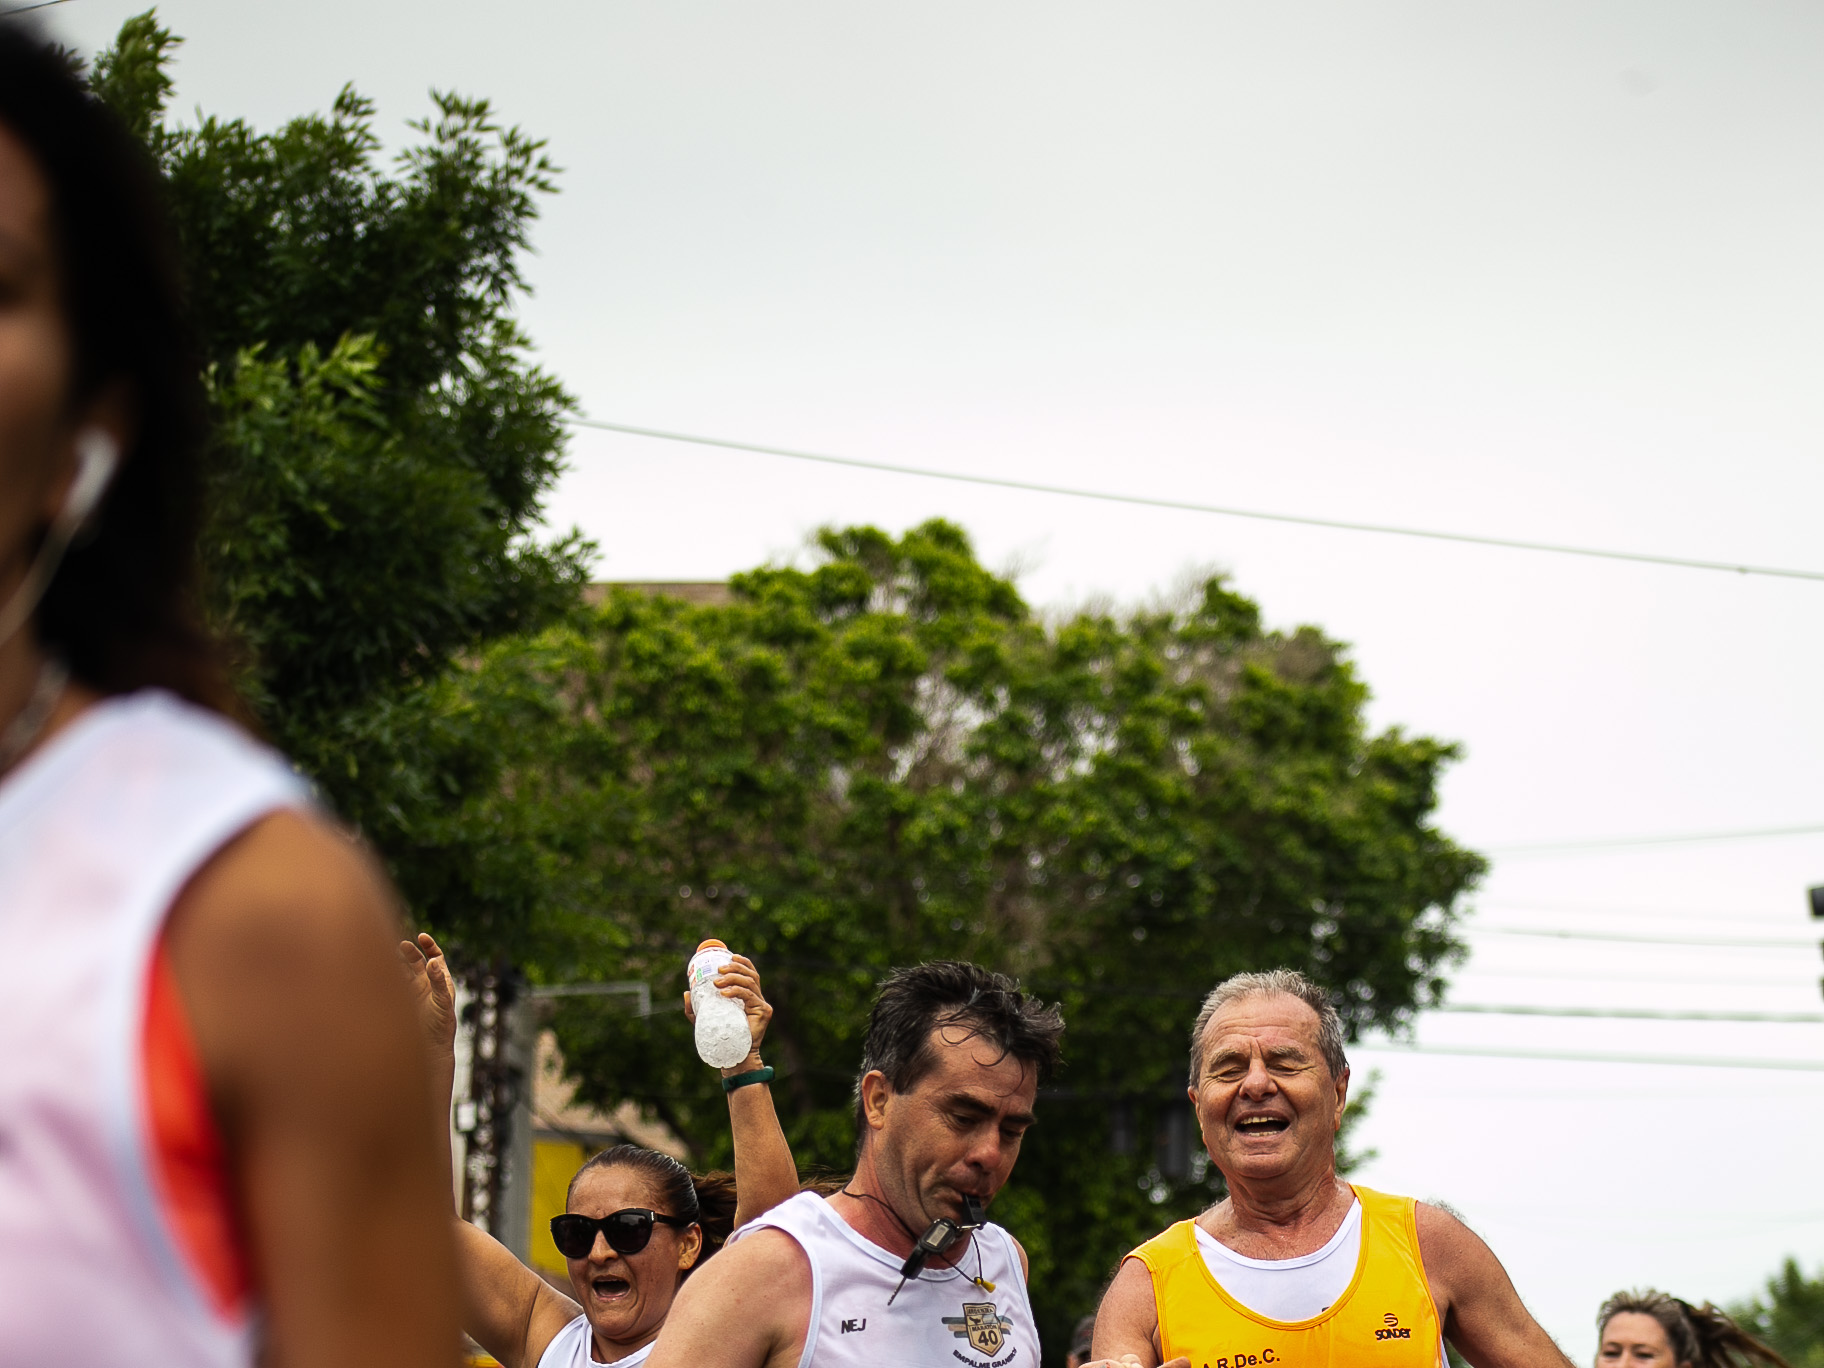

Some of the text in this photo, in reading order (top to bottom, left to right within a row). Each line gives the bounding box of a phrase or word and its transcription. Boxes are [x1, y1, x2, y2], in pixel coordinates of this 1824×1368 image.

[841, 1318, 867, 1334] NEJ
[978, 1329, 999, 1346] 40
[953, 1349, 991, 1368] EMPALME
